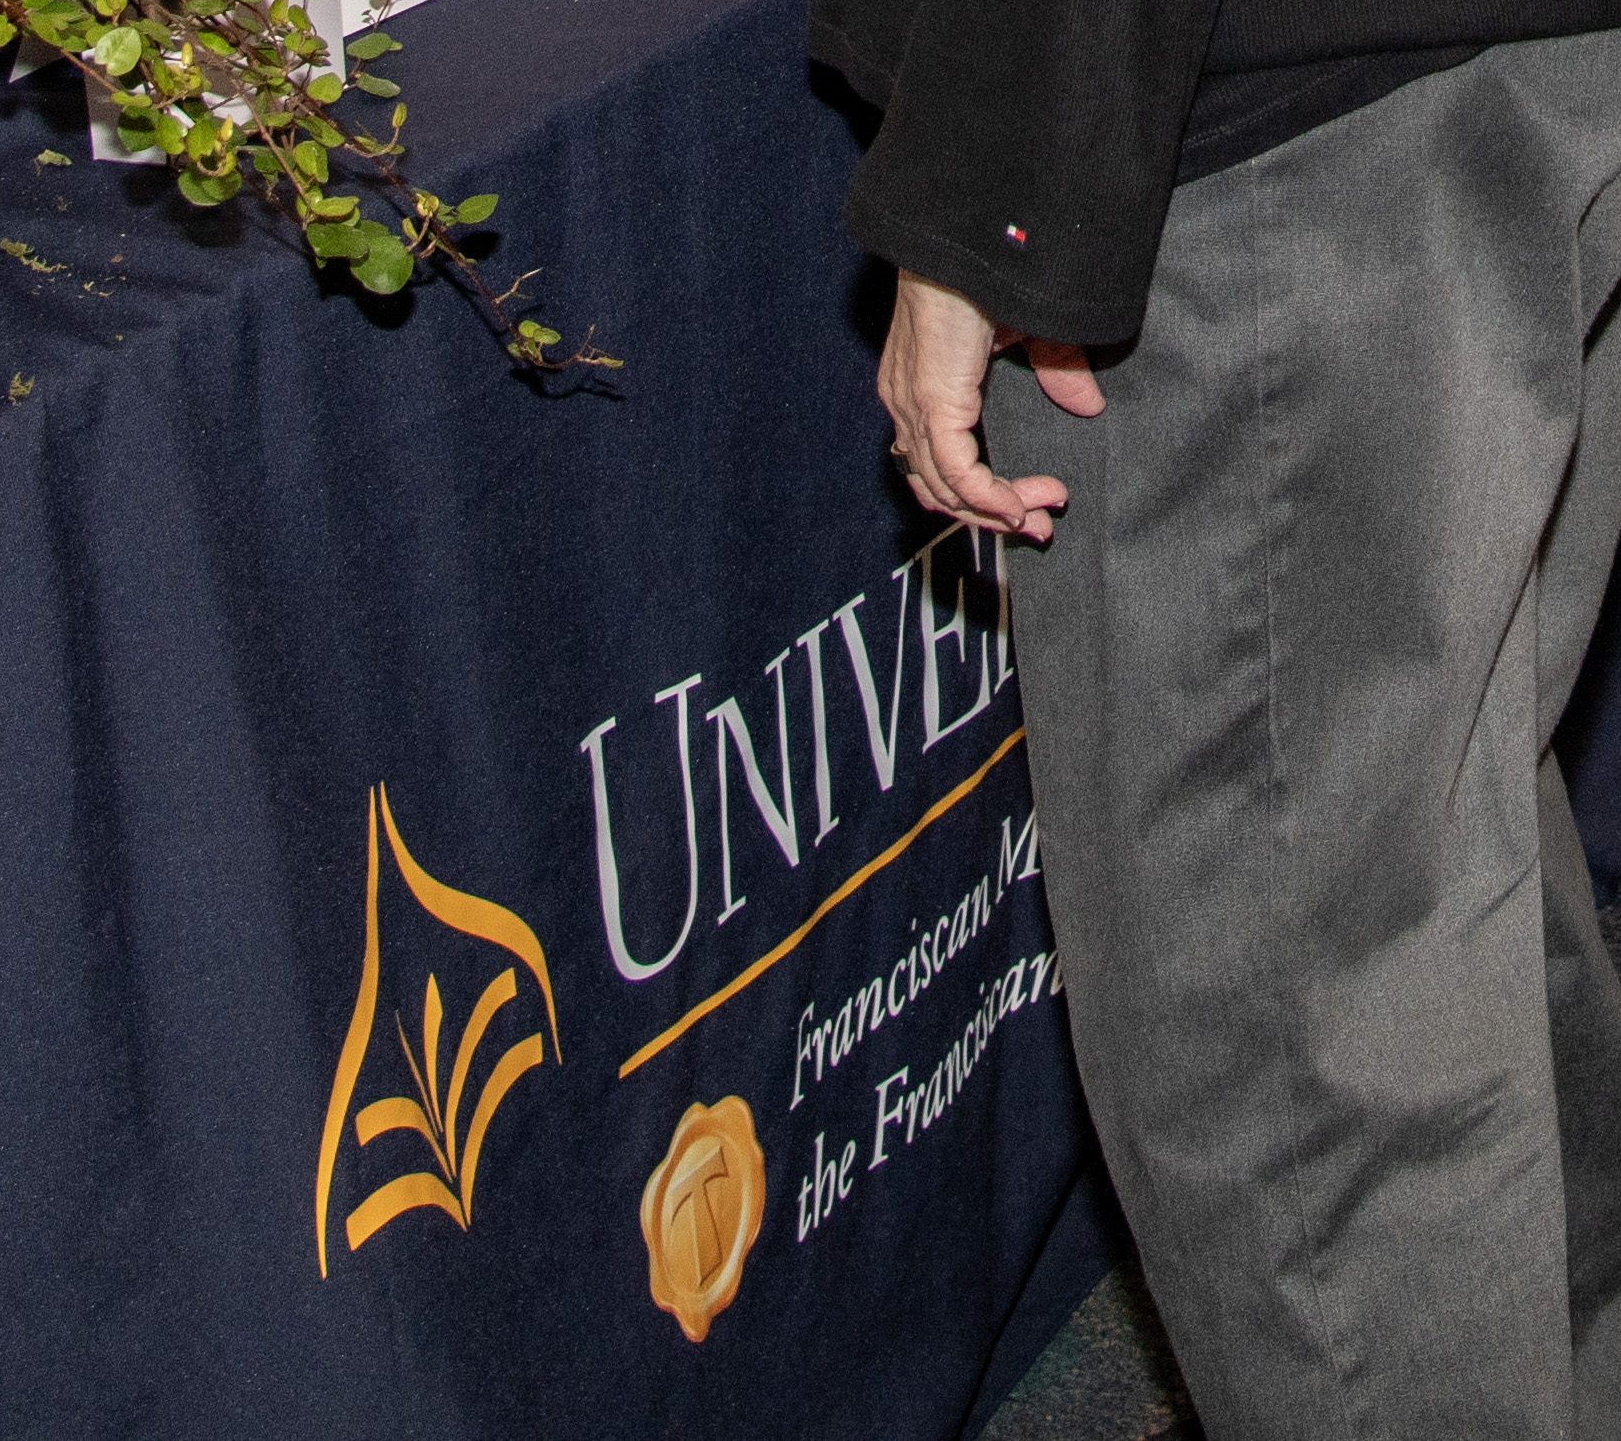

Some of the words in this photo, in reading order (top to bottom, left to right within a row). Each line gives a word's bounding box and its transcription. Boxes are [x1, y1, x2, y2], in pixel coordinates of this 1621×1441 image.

[580, 520, 1014, 981] UNIVE
[788, 874, 992, 1111] Franciscan
[796, 1129, 858, 1243] the
[867, 946, 1066, 1172] Franciscan
